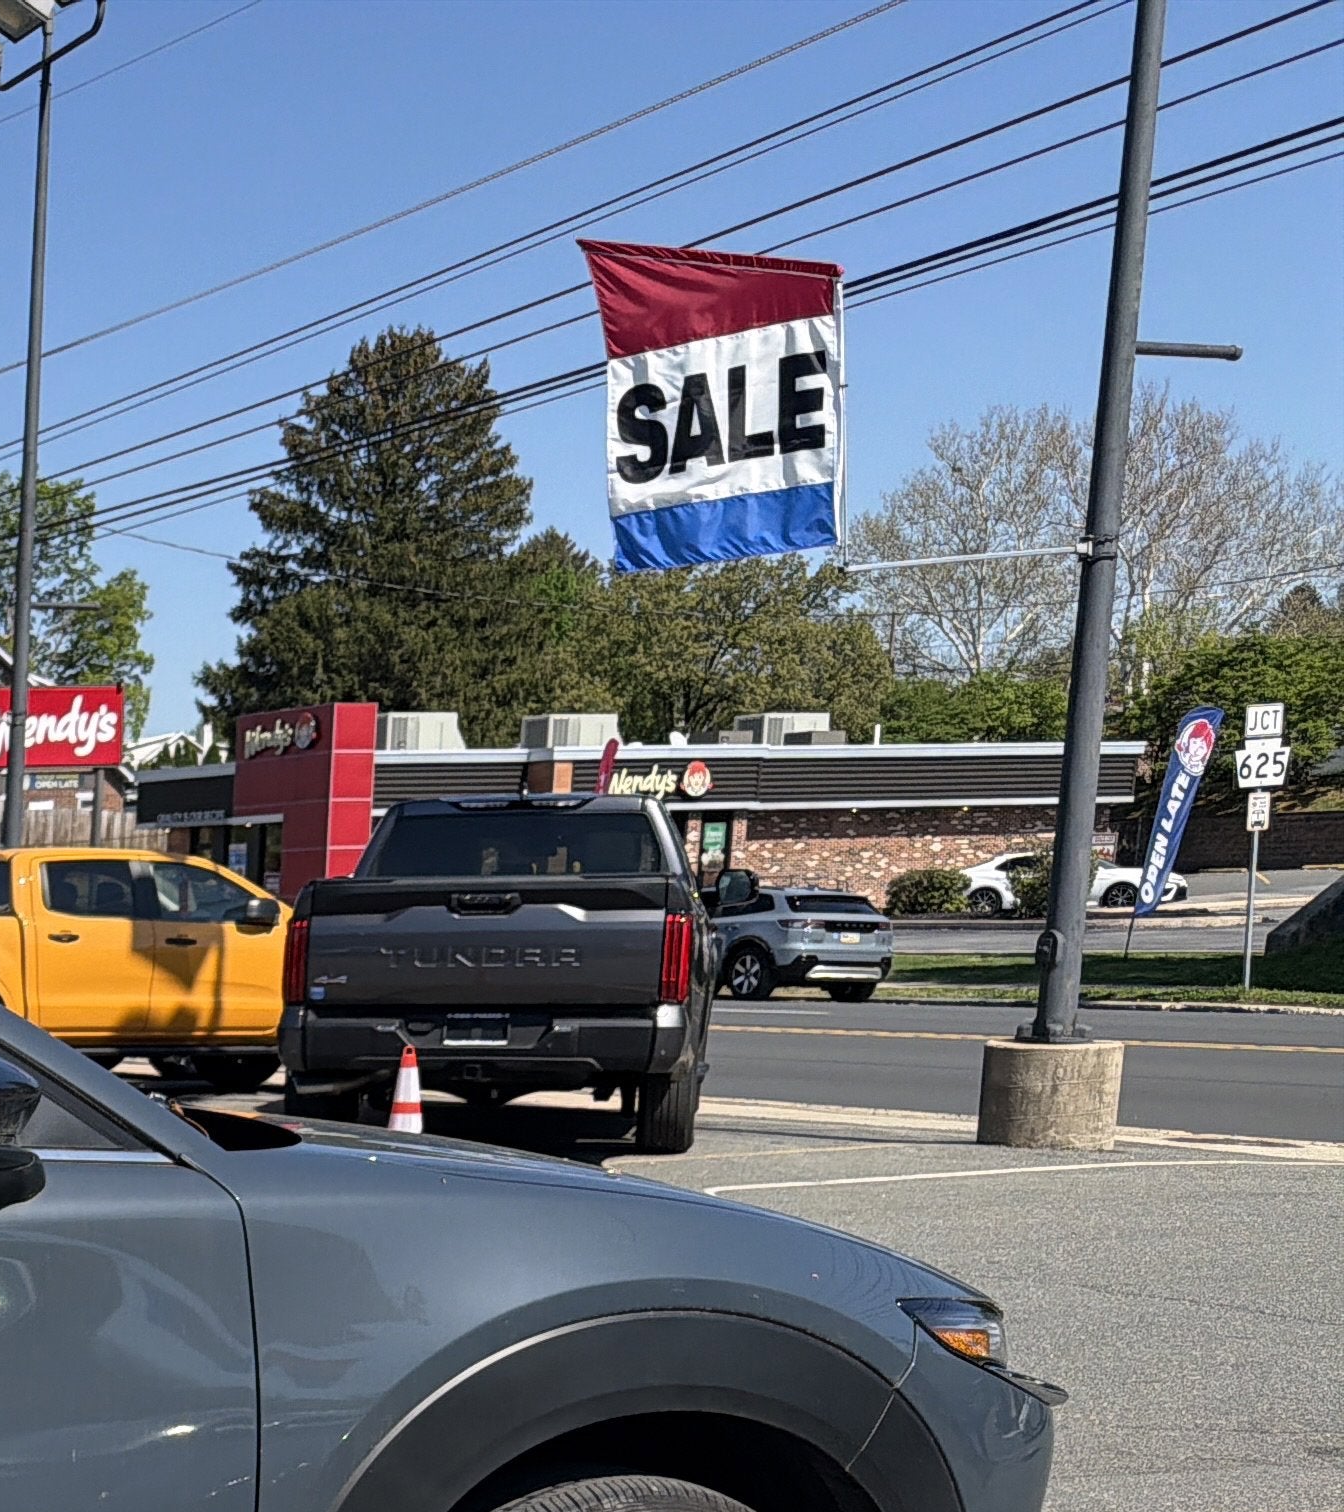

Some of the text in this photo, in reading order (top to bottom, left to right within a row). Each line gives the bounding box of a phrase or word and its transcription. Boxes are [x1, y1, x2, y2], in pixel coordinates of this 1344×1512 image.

[615, 350, 827, 484] SALE
[1249, 710, 1280, 731] JCT
[244, 718, 294, 760] Wendy's
[1239, 750, 1286, 780] 625
[1140, 772, 1192, 904] OPEN LATE
[380, 946, 581, 968] TUNDRA
